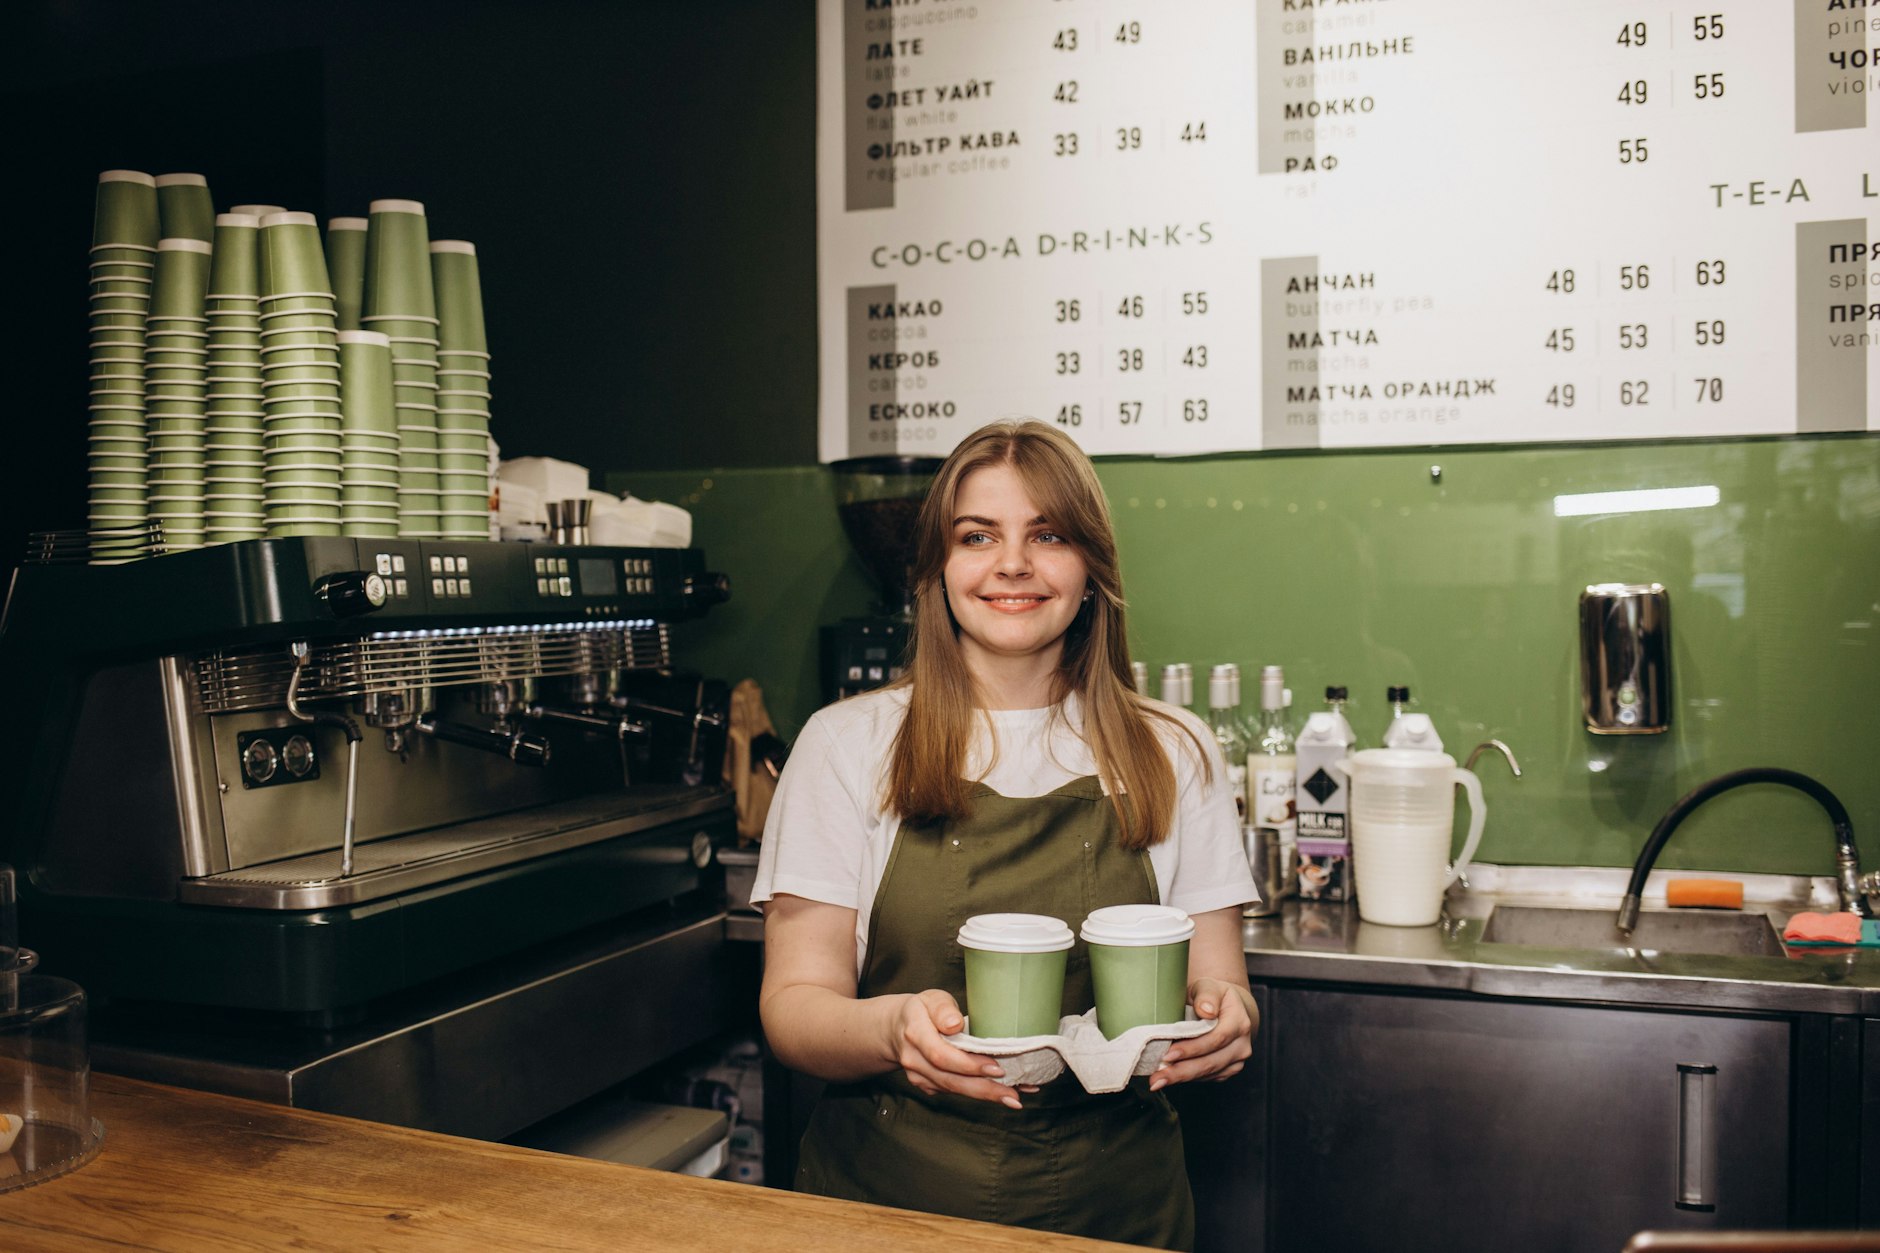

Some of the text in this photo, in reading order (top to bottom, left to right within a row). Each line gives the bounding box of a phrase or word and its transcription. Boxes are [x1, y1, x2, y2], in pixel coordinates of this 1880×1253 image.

[1053, 21, 1141, 51] 43 49
[1617, 14, 1723, 47] 49 55
[866, 38, 923, 60] ЛАТЕ
[1284, 37, 1413, 66] ВАНІЛЬНЕ
[866, 63, 910, 81] latte
[866, 79, 995, 110] ФЛЕТ УАЙТ
[1054, 81, 1079, 104] 42
[1618, 73, 1724, 105] 49 55
[905, 110, 958, 127] white
[1285, 96, 1374, 121] МОККО
[867, 130, 1021, 160] ФІЛЬТР КАВА
[1054, 121, 1206, 157] 33 39 44
[1618, 138, 1648, 164] 55
[867, 156, 1010, 183] regular coffee
[1285, 155, 1338, 173] РАФ
[1710, 178, 1810, 208] T-E-A
[871, 222, 1213, 269] C-O-C-O-A D-R-I-N-K-S
[1286, 272, 1375, 294] АНЧАН
[1546, 260, 1726, 294] 48 56 63
[868, 300, 942, 320] КАКАО
[1055, 292, 1208, 323] 36 46 55
[1393, 296, 1434, 313] pea
[868, 325, 927, 341] cocoa
[1288, 329, 1379, 349] МАТЧА
[1545, 320, 1725, 352] 45 53 59
[868, 351, 939, 370] КЕРОБ
[1056, 346, 1208, 375] 33 38 43
[1287, 354, 1370, 373] matcha
[868, 375, 927, 392] carob
[1287, 378, 1497, 403] МАТЧА ОРАНДЖ
[1546, 384, 1575, 409] 49
[1620, 381, 1650, 407] 62
[869, 401, 956, 421] ЕСКОКО
[1057, 399, 1208, 428] 46 57 63
[1286, 405, 1461, 426] matcha orange
